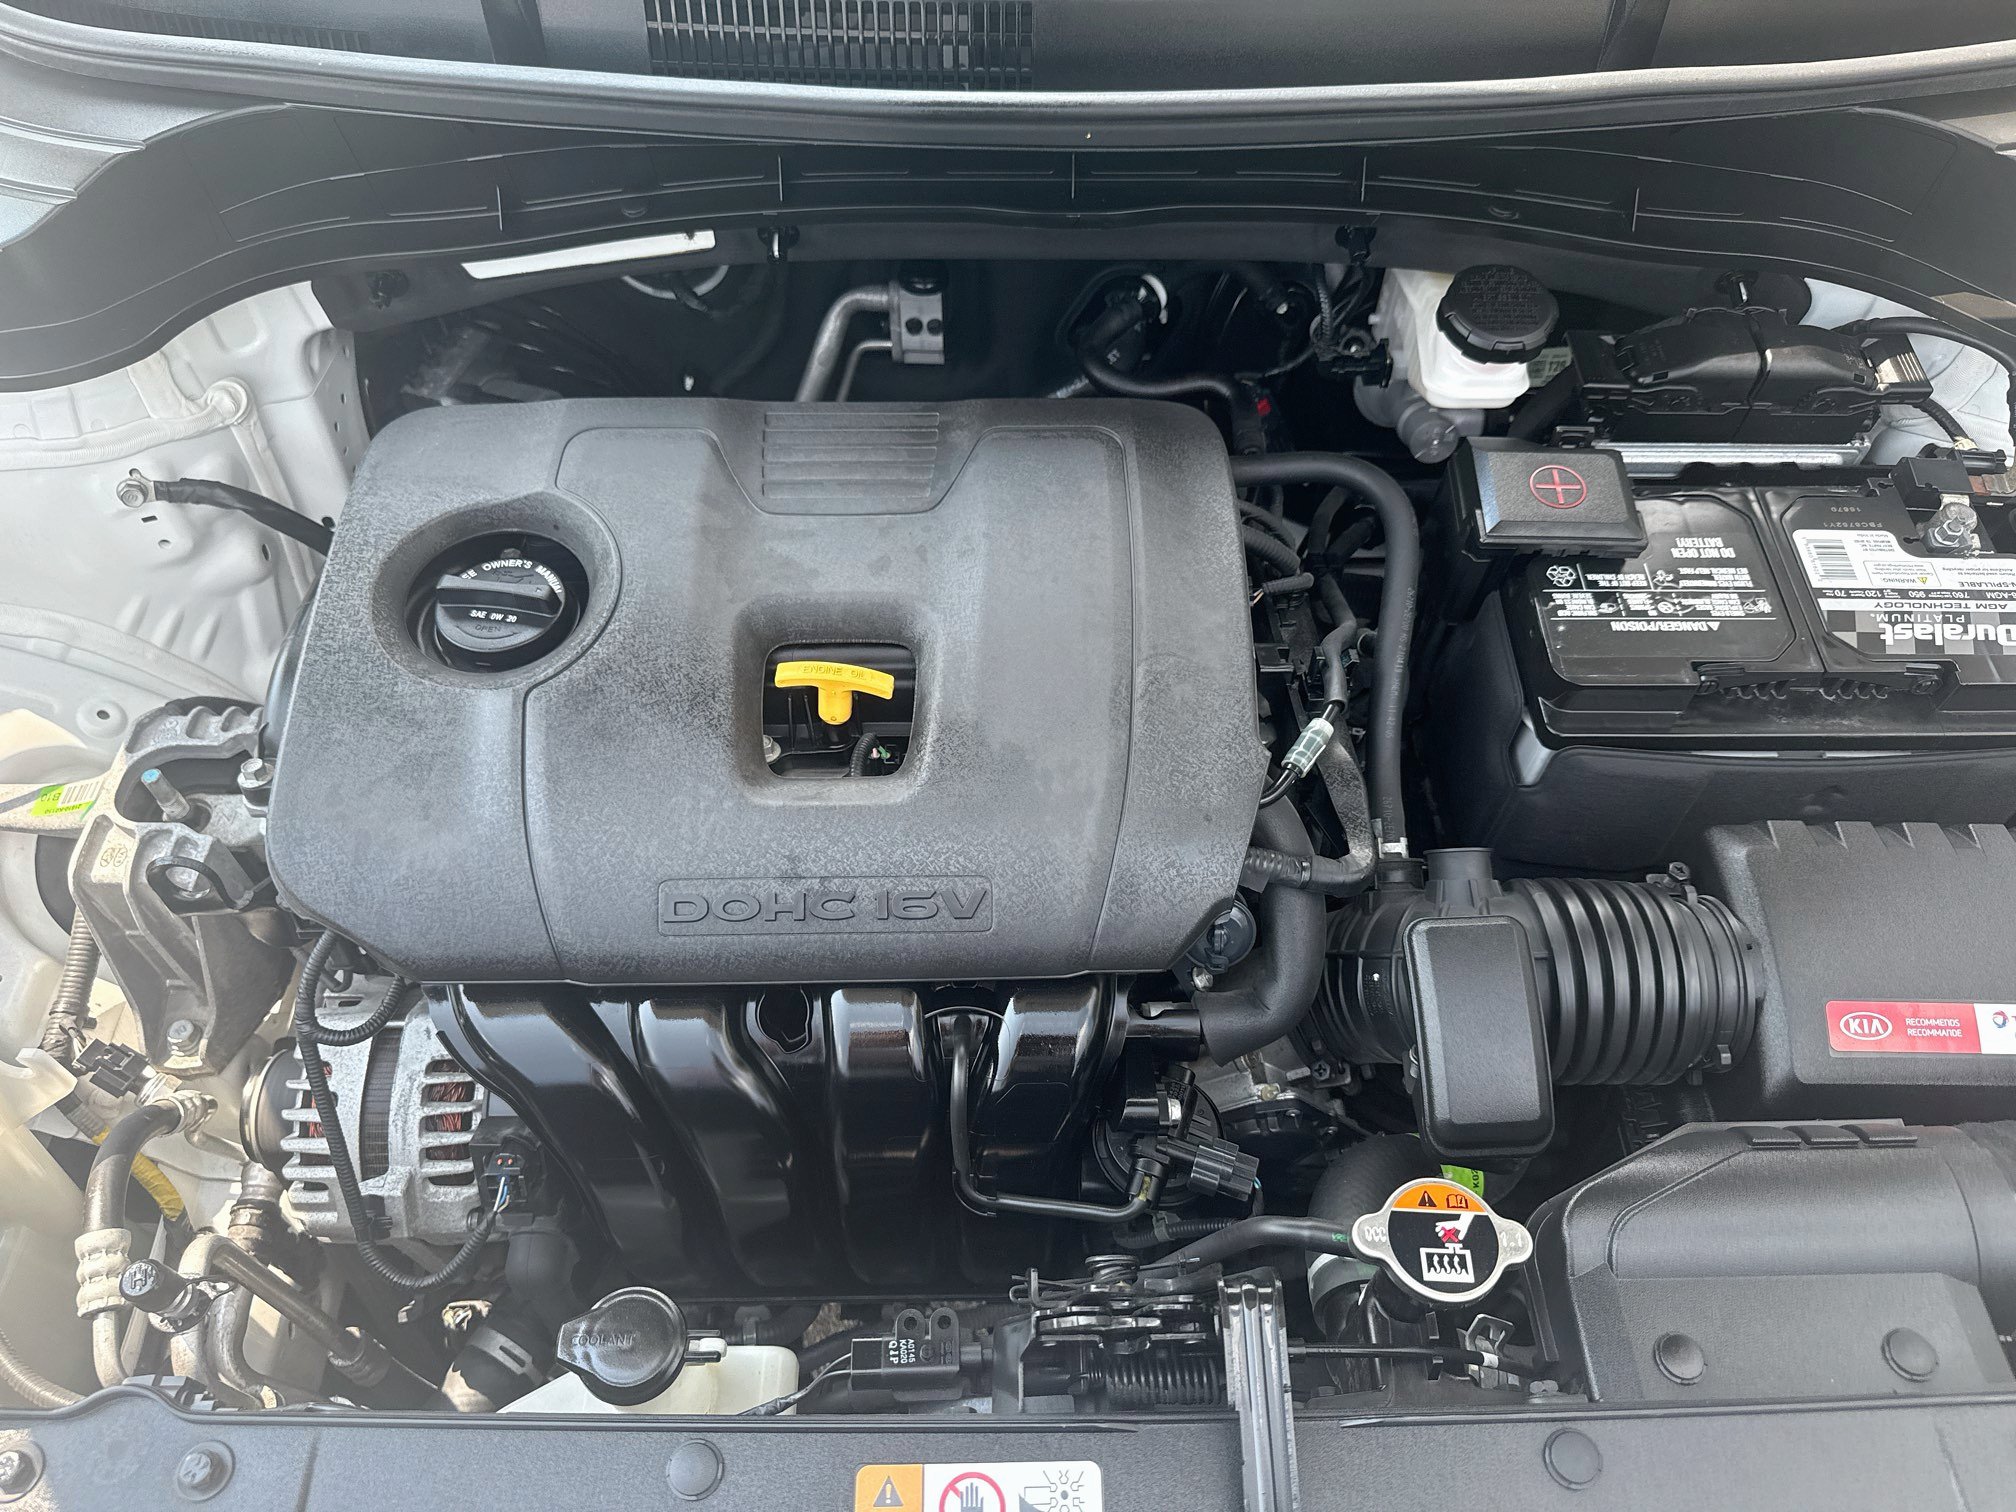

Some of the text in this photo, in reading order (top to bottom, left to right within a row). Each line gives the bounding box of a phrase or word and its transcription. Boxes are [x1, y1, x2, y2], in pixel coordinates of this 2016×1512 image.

[1675, 537, 1724, 548] BATTERY!
[1671, 547, 1736, 559] DO NOT OPEN
[459, 568, 479, 580] EE
[481, 559, 534, 572] OWNER'S
[1873, 600, 2008, 610] AGM TECHNOLOGY
[469, 609, 487, 619] SAE
[505, 614, 518, 623] 20
[475, 623, 501, 633] OPEN
[1610, 620, 1709, 632] DANGER/POISON
[803, 664, 865, 680] ENGINE OIL
[663, 889, 988, 923] DOHC 16V
[1848, 1017, 1885, 1035] KIA
[1905, 1017, 1961, 1028] RECOMMENDS
[1907, 1028, 1963, 1038] RECOMMANDE
[572, 1333, 636, 1347] COOLANT
[899, 1339, 908, 1365] KA020
[907, 1338, 916, 1364] A0145
